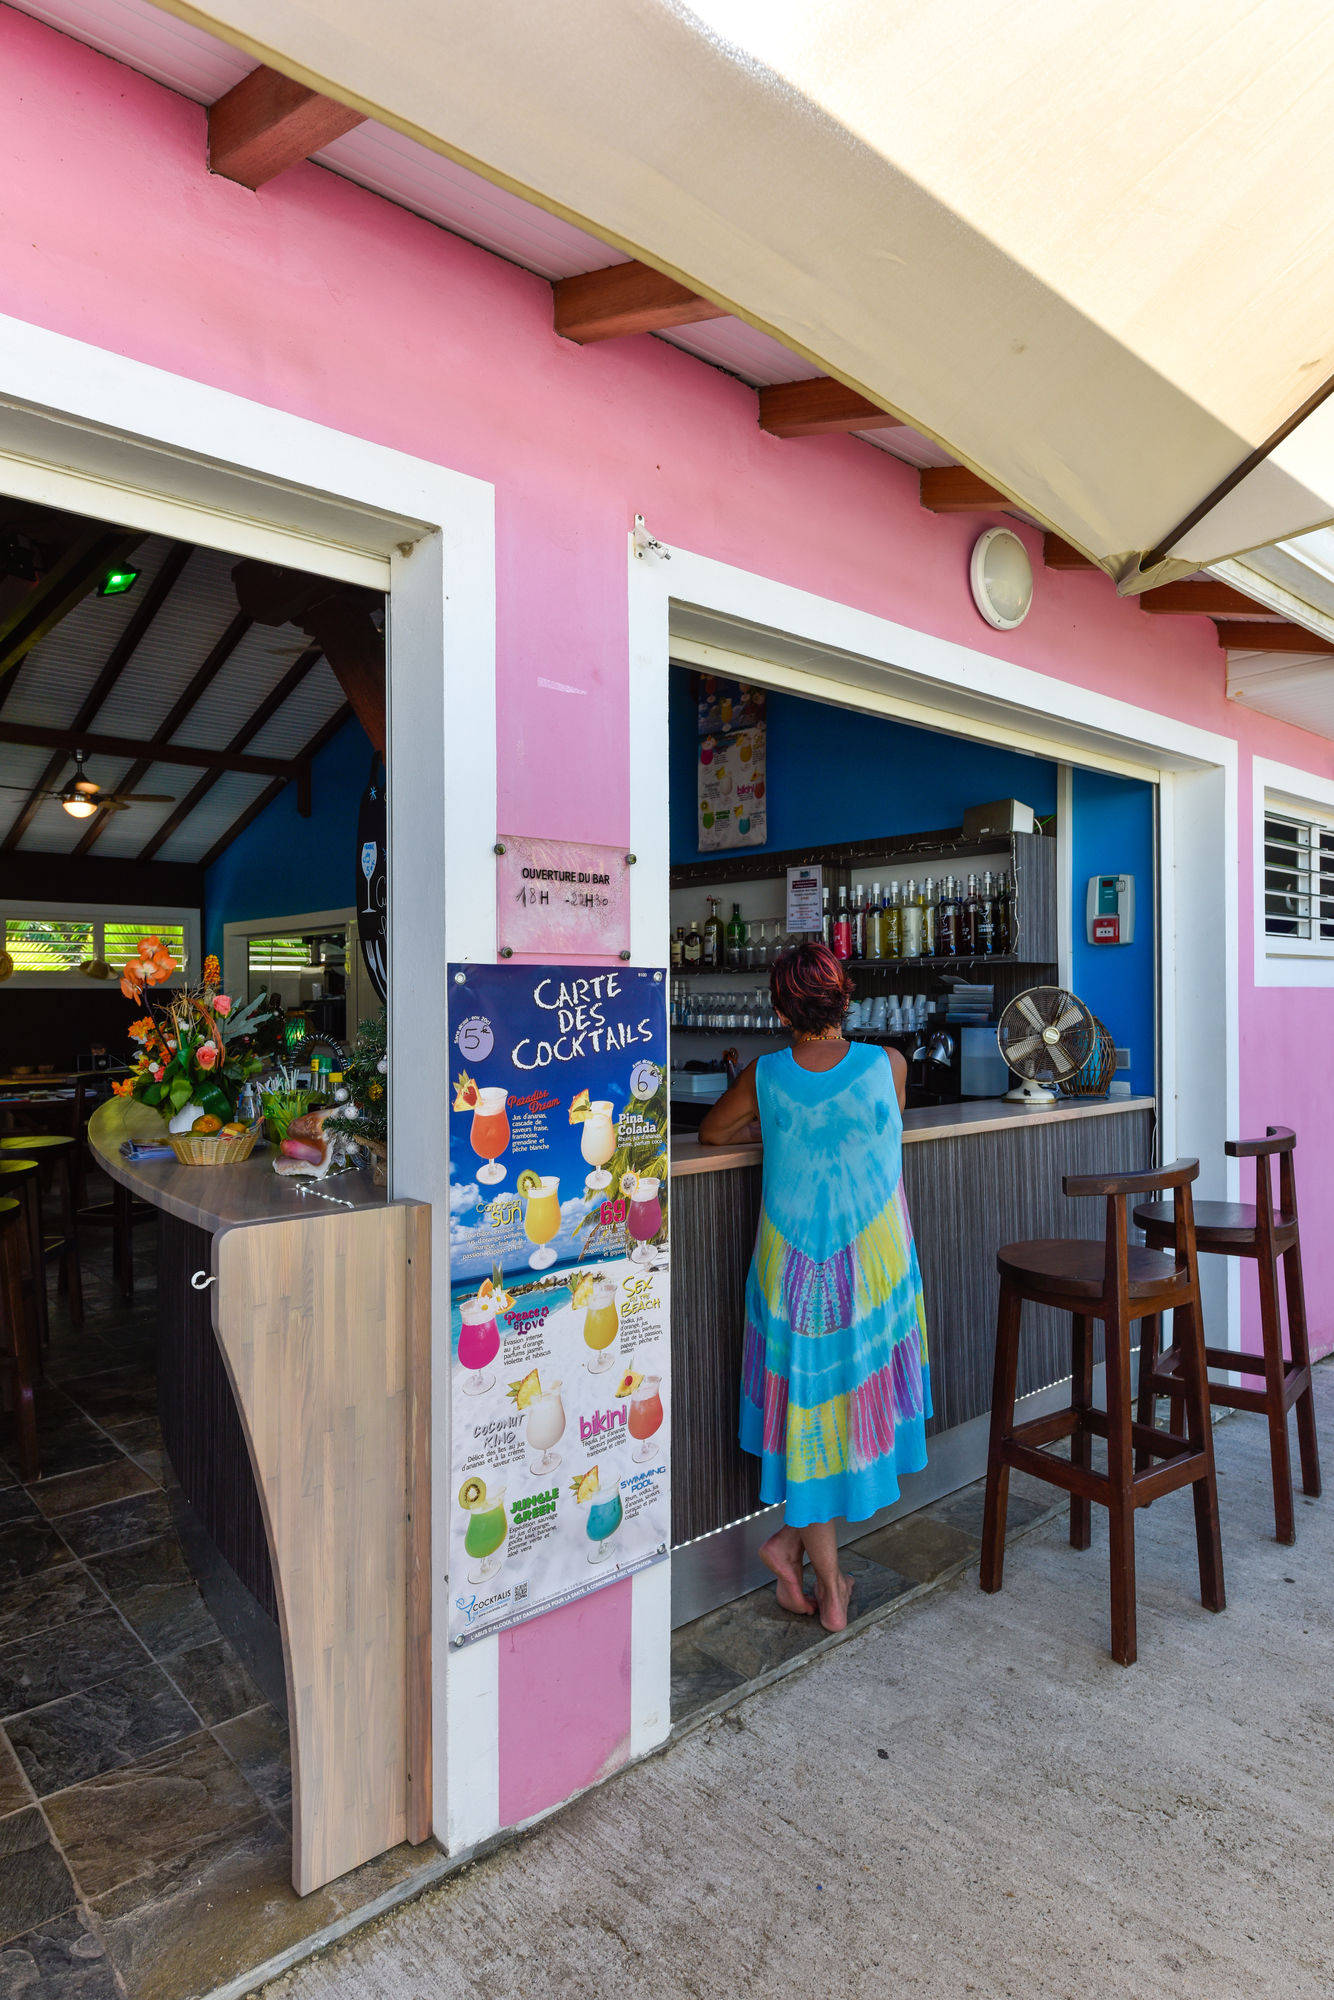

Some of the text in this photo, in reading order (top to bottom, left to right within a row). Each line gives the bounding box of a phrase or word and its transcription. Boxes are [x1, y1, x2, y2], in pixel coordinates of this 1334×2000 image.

[522, 868, 610, 885] OUVERTURE DU BAR
[533, 972, 622, 1010] CARTE
[558, 1002, 605, 1033] DES
[512, 1018, 653, 1070] COCKTAILS
[507, 1089, 549, 1109] Paradise
[528, 1098, 560, 1113] Dream
[618, 1112, 644, 1124] Pina
[617, 1124, 657, 1135] Colada
[512, 1139, 537, 1147] grenadine
[512, 1145, 527, 1154] pêche
[476, 1199, 522, 1213] Caribbean
[600, 1198, 626, 1225] 69
[504, 1307, 540, 1325] Peace
[620, 1298, 661, 1318] BEACH
[525, 1333, 543, 1341] intense
[503, 1351, 525, 1360] parfums
[512, 1345, 521, 1353] jus
[503, 1357, 523, 1366] violette
[532, 1350, 551, 1359] hibiscus
[579, 1404, 627, 1441] bikini
[483, 1431, 516, 1449] KING
[614, 1438, 627, 1447] citron
[467, 1453, 484, 1463] Délice
[486, 1449, 496, 1457] des
[492, 1454, 526, 1468] saveur coco
[461, 1460, 486, 1472] d'ananas
[620, 1465, 666, 1489] SWIMMING
[631, 1479, 654, 1493] POOL
[510, 1487, 560, 1514] JUNGLE
[513, 1501, 556, 1524] GREEN
[509, 1513, 558, 1534] Expédition sauvage
[508, 1541, 528, 1553] pomme
[529, 1535, 543, 1543] verte
[515, 1531, 525, 1540] jus
[472, 1589, 512, 1611] COCKTALIS
[512, 1615, 522, 1624] EST
[522, 1603, 552, 1619] DANGEREUX
[551, 1597, 564, 1607] POUR
